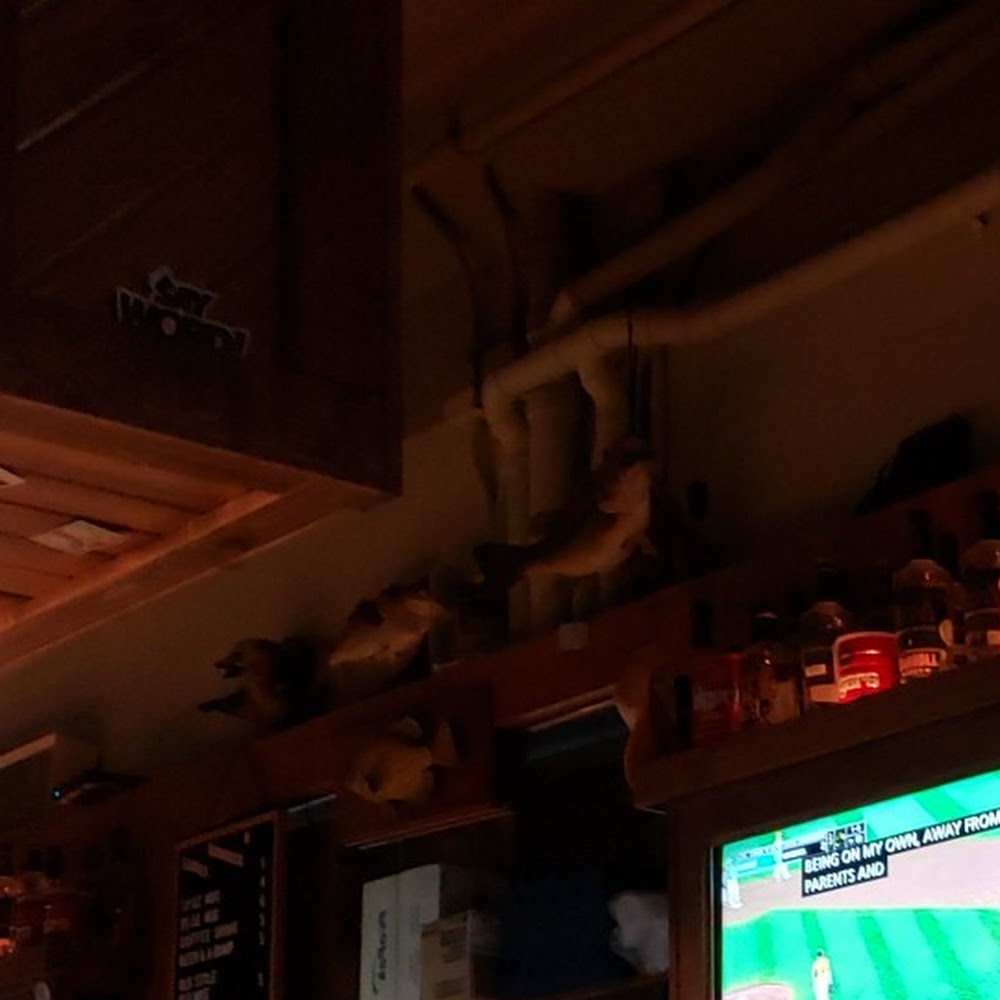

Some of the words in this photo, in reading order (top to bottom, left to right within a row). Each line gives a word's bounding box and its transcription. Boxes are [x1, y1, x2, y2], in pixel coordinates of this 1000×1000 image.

[804, 852, 840, 874] BEING
[841, 845, 862, 865] ON
[863, 841, 884, 862] MY
[922, 821, 964, 844] AWAY
[804, 869, 856, 894] PARENTS
[857, 861, 886, 882] AND
